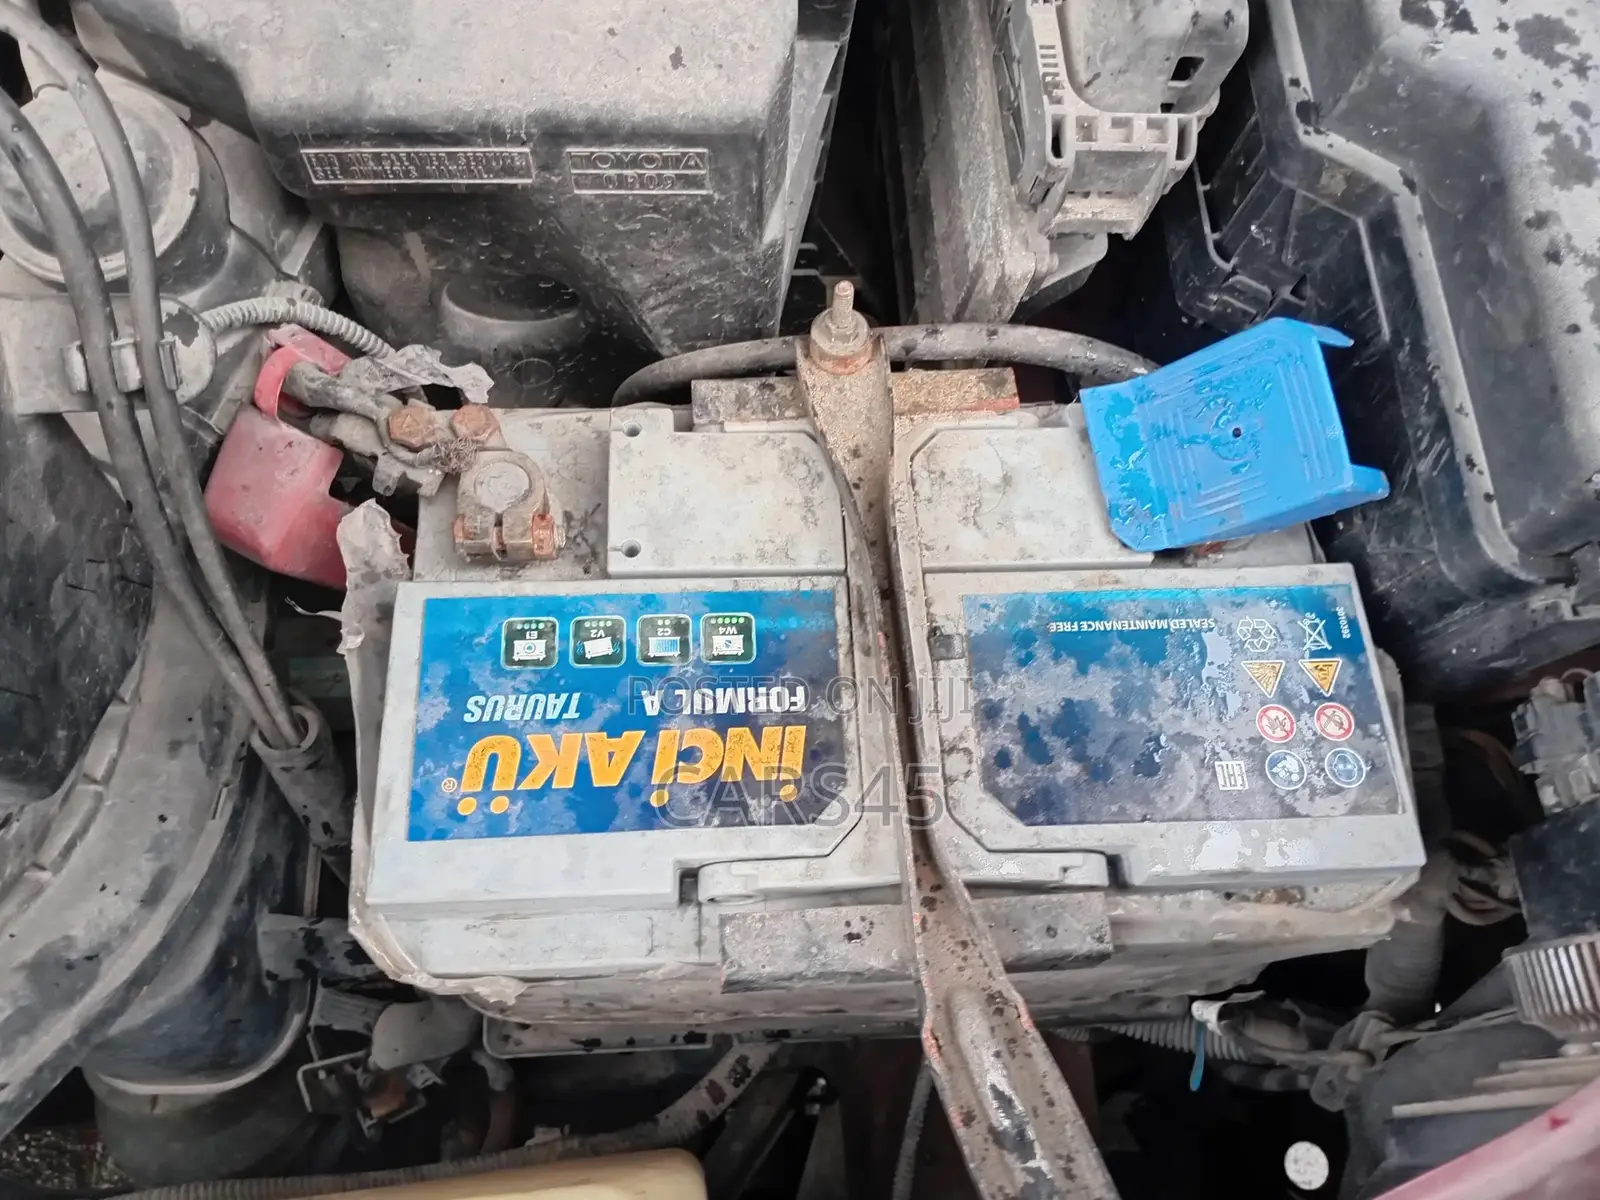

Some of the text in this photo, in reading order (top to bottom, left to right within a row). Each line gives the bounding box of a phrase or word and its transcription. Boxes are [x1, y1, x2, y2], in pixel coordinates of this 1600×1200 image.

[570, 152, 706, 170] TOYOTA
[657, 627, 672, 636] C2
[718, 627, 738, 636] W4
[1048, 618, 1216, 633] SEALED MAINTENANCE FREE
[590, 629, 606, 638] V2
[463, 691, 582, 723] TAURUS
